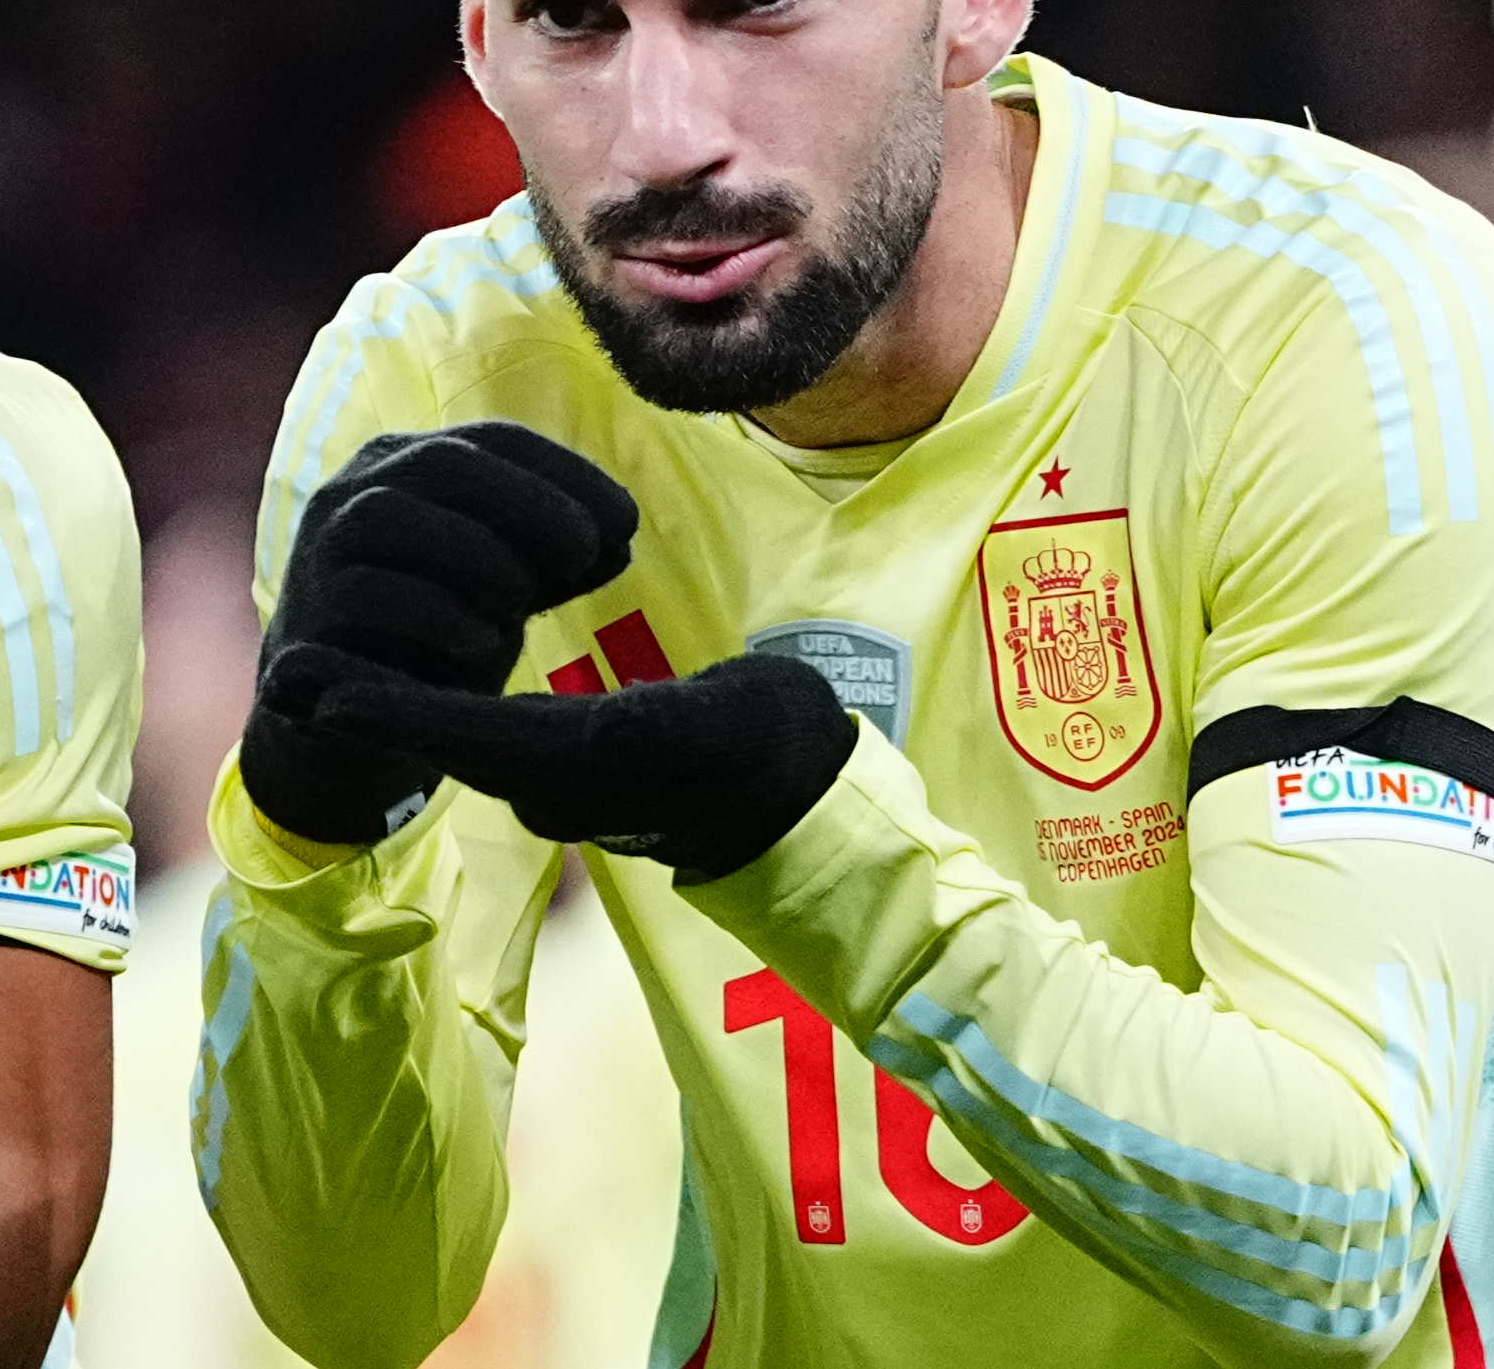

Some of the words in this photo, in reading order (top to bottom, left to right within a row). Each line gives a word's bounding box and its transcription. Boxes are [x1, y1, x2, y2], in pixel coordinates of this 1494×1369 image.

[798, 633, 855, 655] UEFA
[1034, 815, 1104, 840] DENMARK
[1121, 802, 1174, 830] SPAIN
[1048, 832, 1136, 862] NOVEMBER
[1142, 814, 1185, 848] 2024
[1058, 848, 1167, 883] COPENHAGEN
